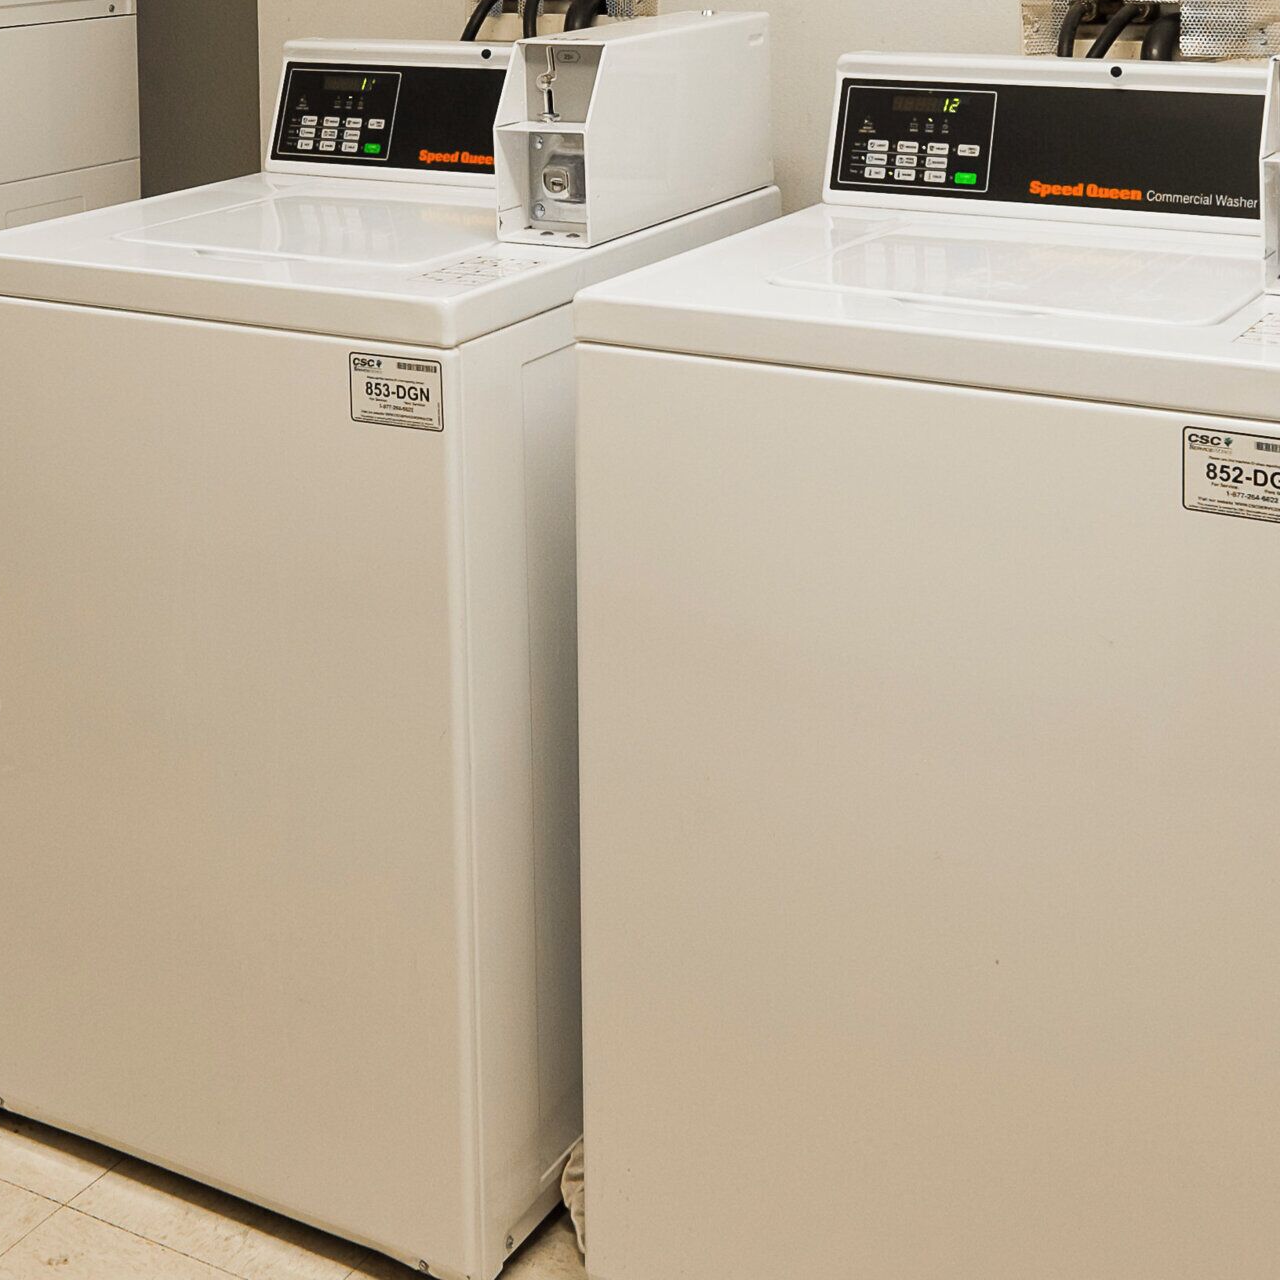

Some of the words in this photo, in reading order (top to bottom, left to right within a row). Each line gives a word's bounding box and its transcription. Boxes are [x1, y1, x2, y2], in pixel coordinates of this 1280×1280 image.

[943, 98, 960, 113] 12
[419, 149, 458, 164] Speed
[461, 152, 494, 165] Quee
[1029, 180, 1084, 199] Speed
[1086, 183, 1142, 201] Queen
[1146, 189, 1212, 206] Commercial
[1216, 194, 1258, 209] Washer
[353, 358, 374, 367] CSC
[366, 381, 430, 402] 853-DGN
[1188, 434, 1222, 446] CSC
[1227, 491, 1279, 504] 1-877-264-6622
